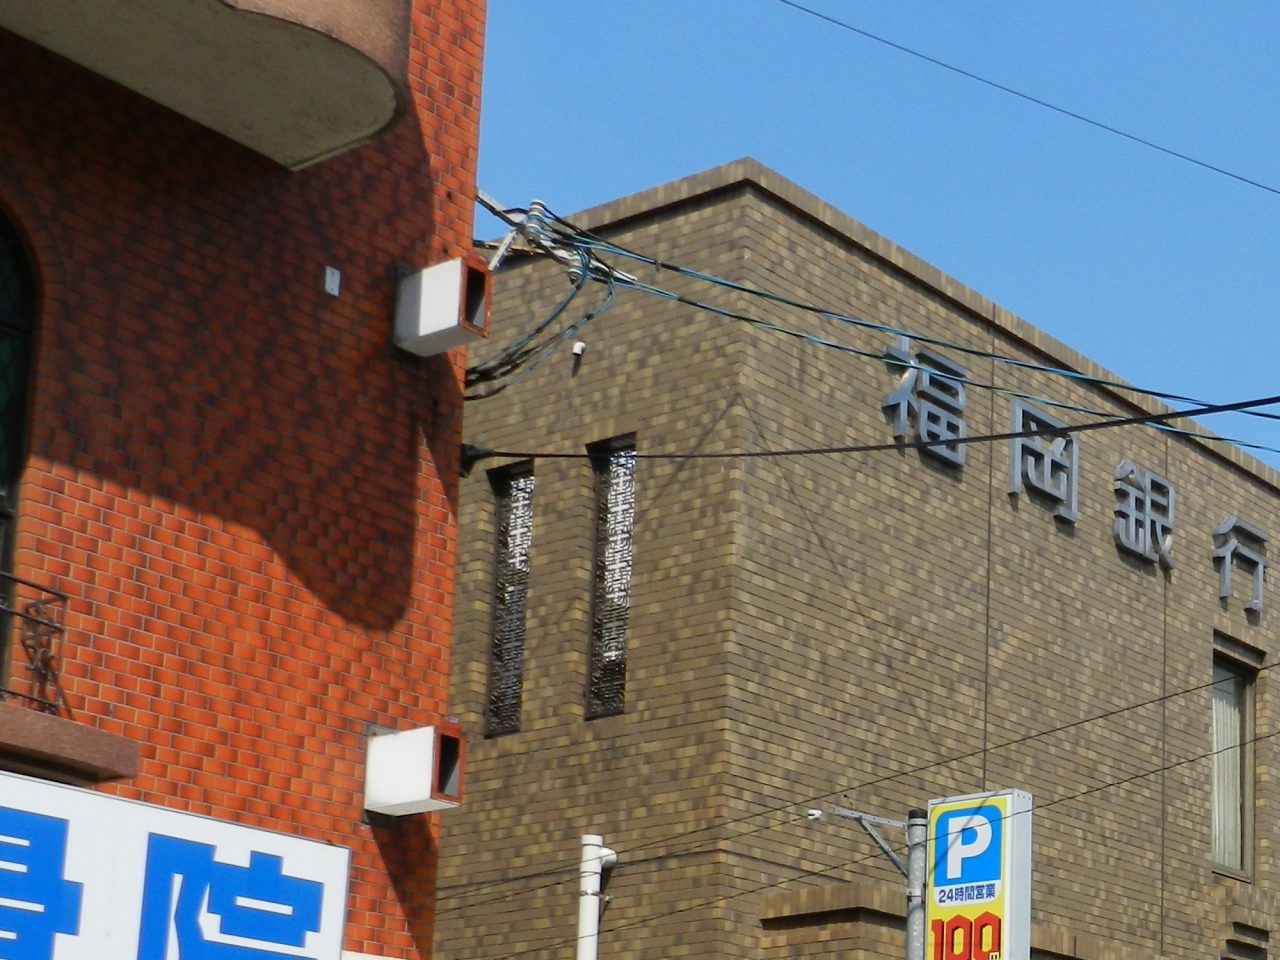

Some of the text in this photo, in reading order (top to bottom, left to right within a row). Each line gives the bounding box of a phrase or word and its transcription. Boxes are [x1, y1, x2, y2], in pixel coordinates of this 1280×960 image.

[882, 337, 1269, 615] 福岡銀行
[946, 815, 993, 880] P
[937, 882, 996, 904] 24時間営業
